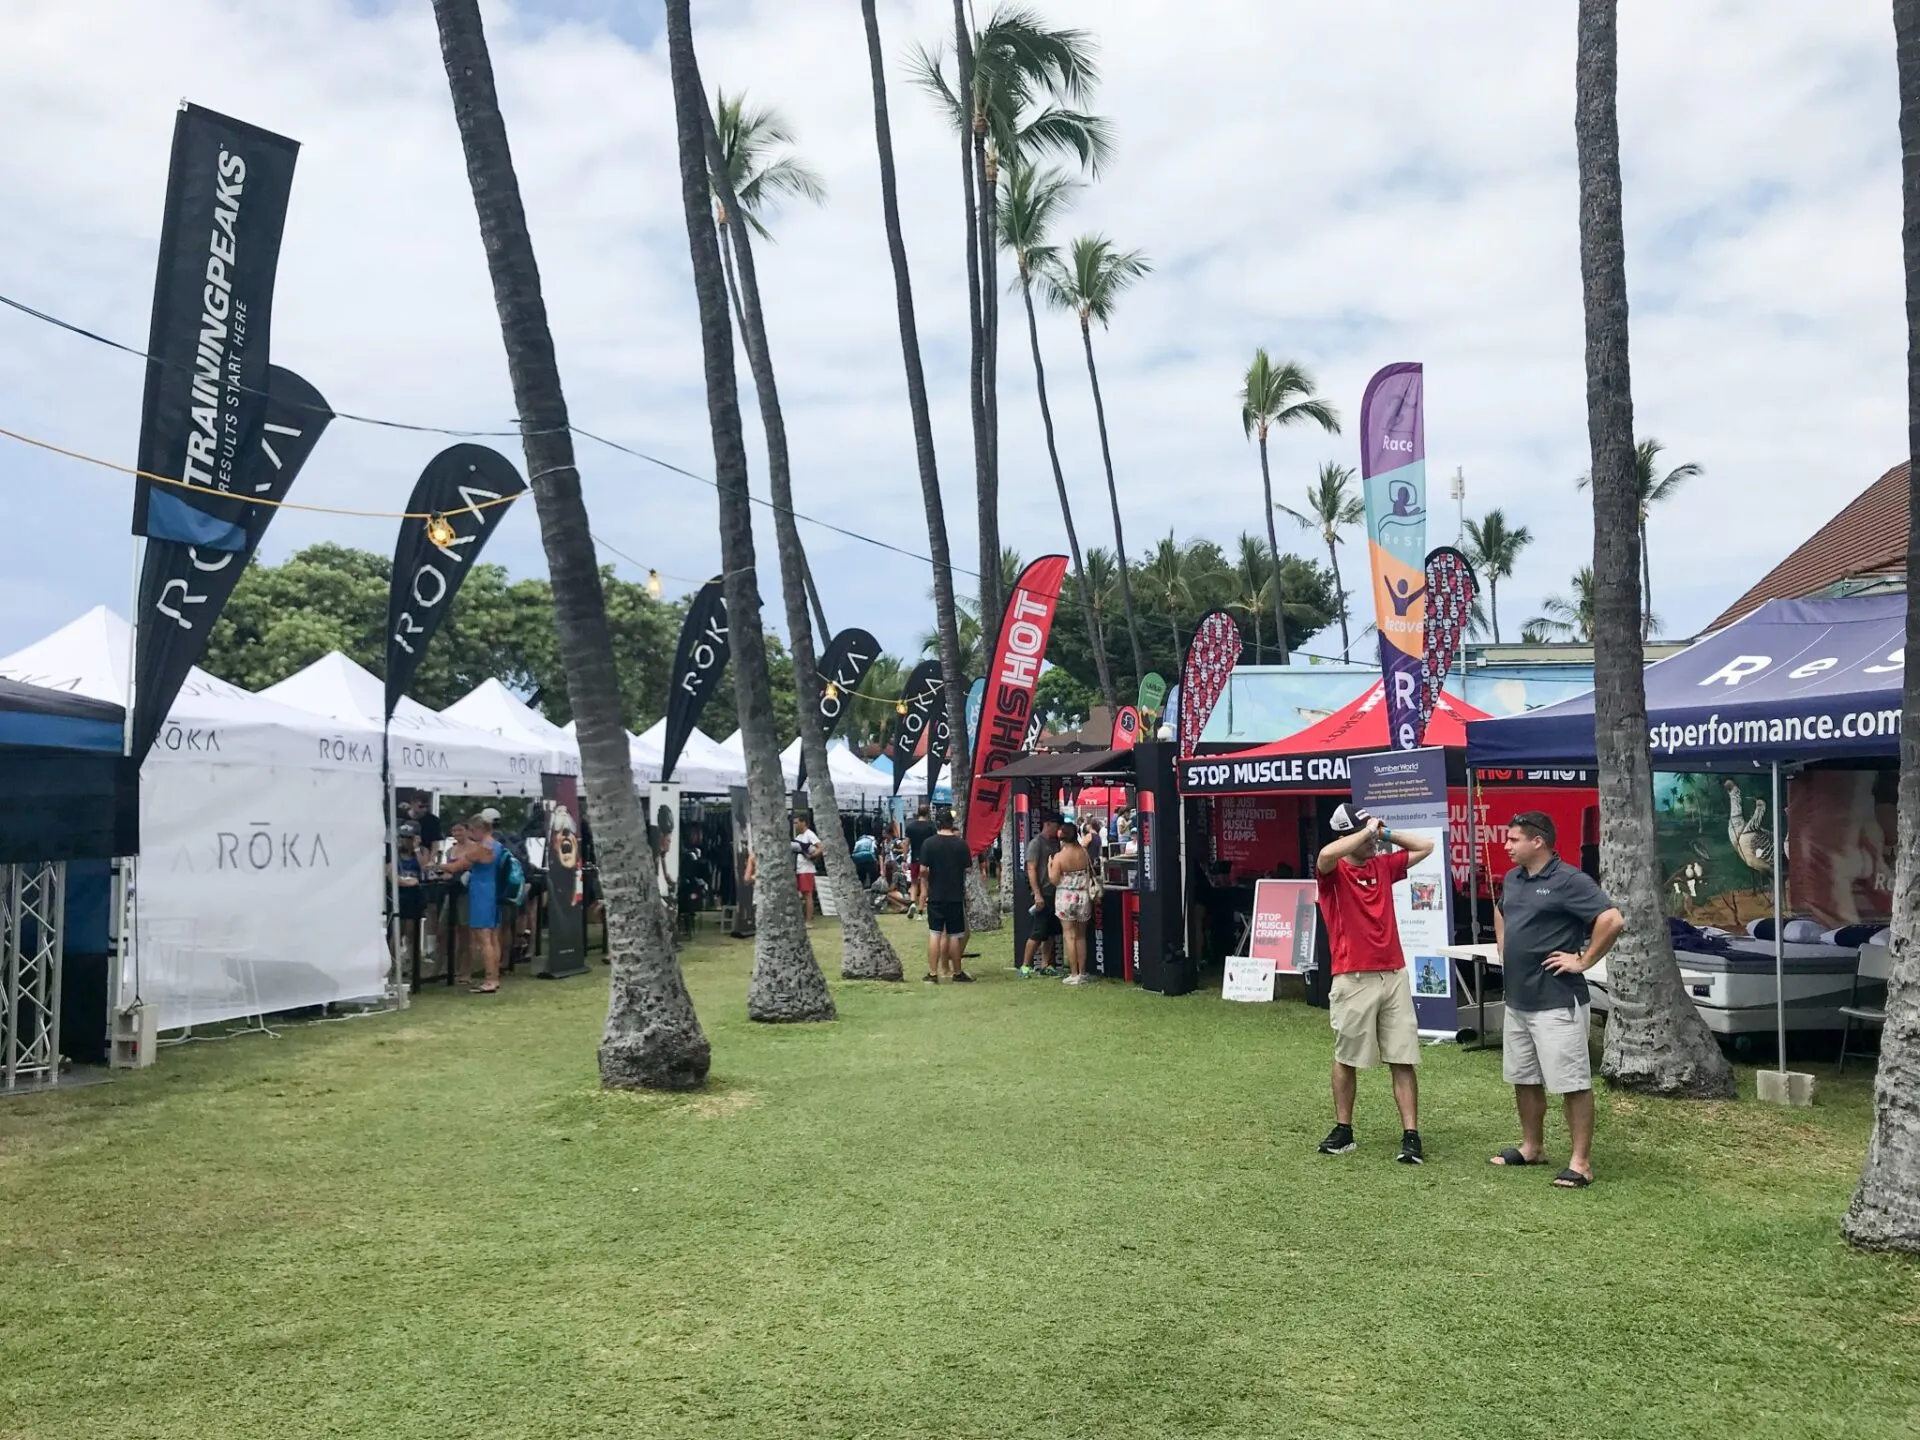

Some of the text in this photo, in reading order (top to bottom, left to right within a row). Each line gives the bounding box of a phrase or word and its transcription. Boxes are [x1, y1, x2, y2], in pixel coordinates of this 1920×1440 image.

[182, 148, 246, 488] TRAININGPEAKS
[218, 299, 248, 493] RESULTS START HERE
[1383, 435, 1414, 452] Race
[1187, 766, 1230, 786] STOP
[1234, 760, 1303, 784] MUSCLE
[1223, 820, 1255, 830] MUSCLE
[1257, 912, 1282, 922] STOP
[1256, 921, 1292, 930] MUSCLE
[1255, 929, 1293, 938] CRAMPS
